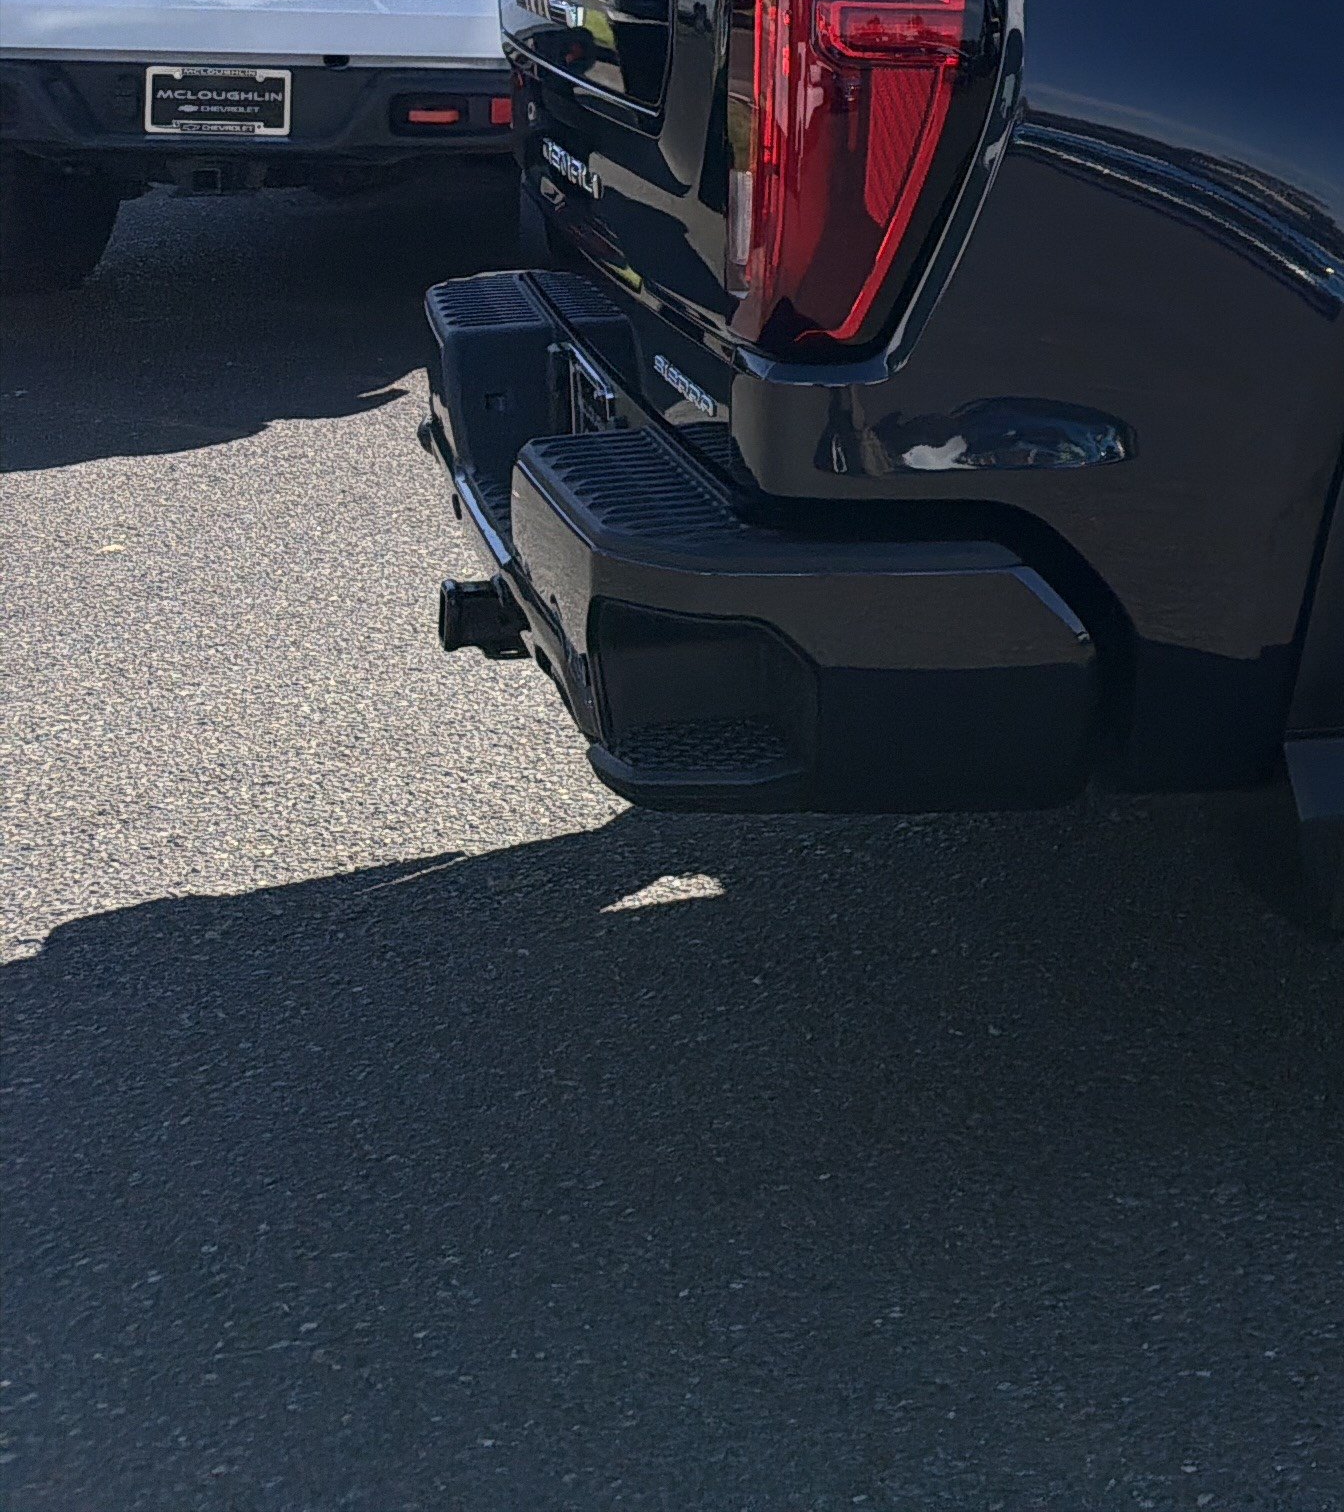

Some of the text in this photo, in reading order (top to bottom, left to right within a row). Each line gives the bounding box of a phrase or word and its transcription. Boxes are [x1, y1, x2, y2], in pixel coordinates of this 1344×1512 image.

[156, 89, 283, 102] MCLOUGHLIN
[200, 105, 260, 113] CHEVROLET
[202, 124, 255, 133] CHEVROLET
[542, 137, 600, 200] DENALI
[653, 355, 714, 417] SIERRA
